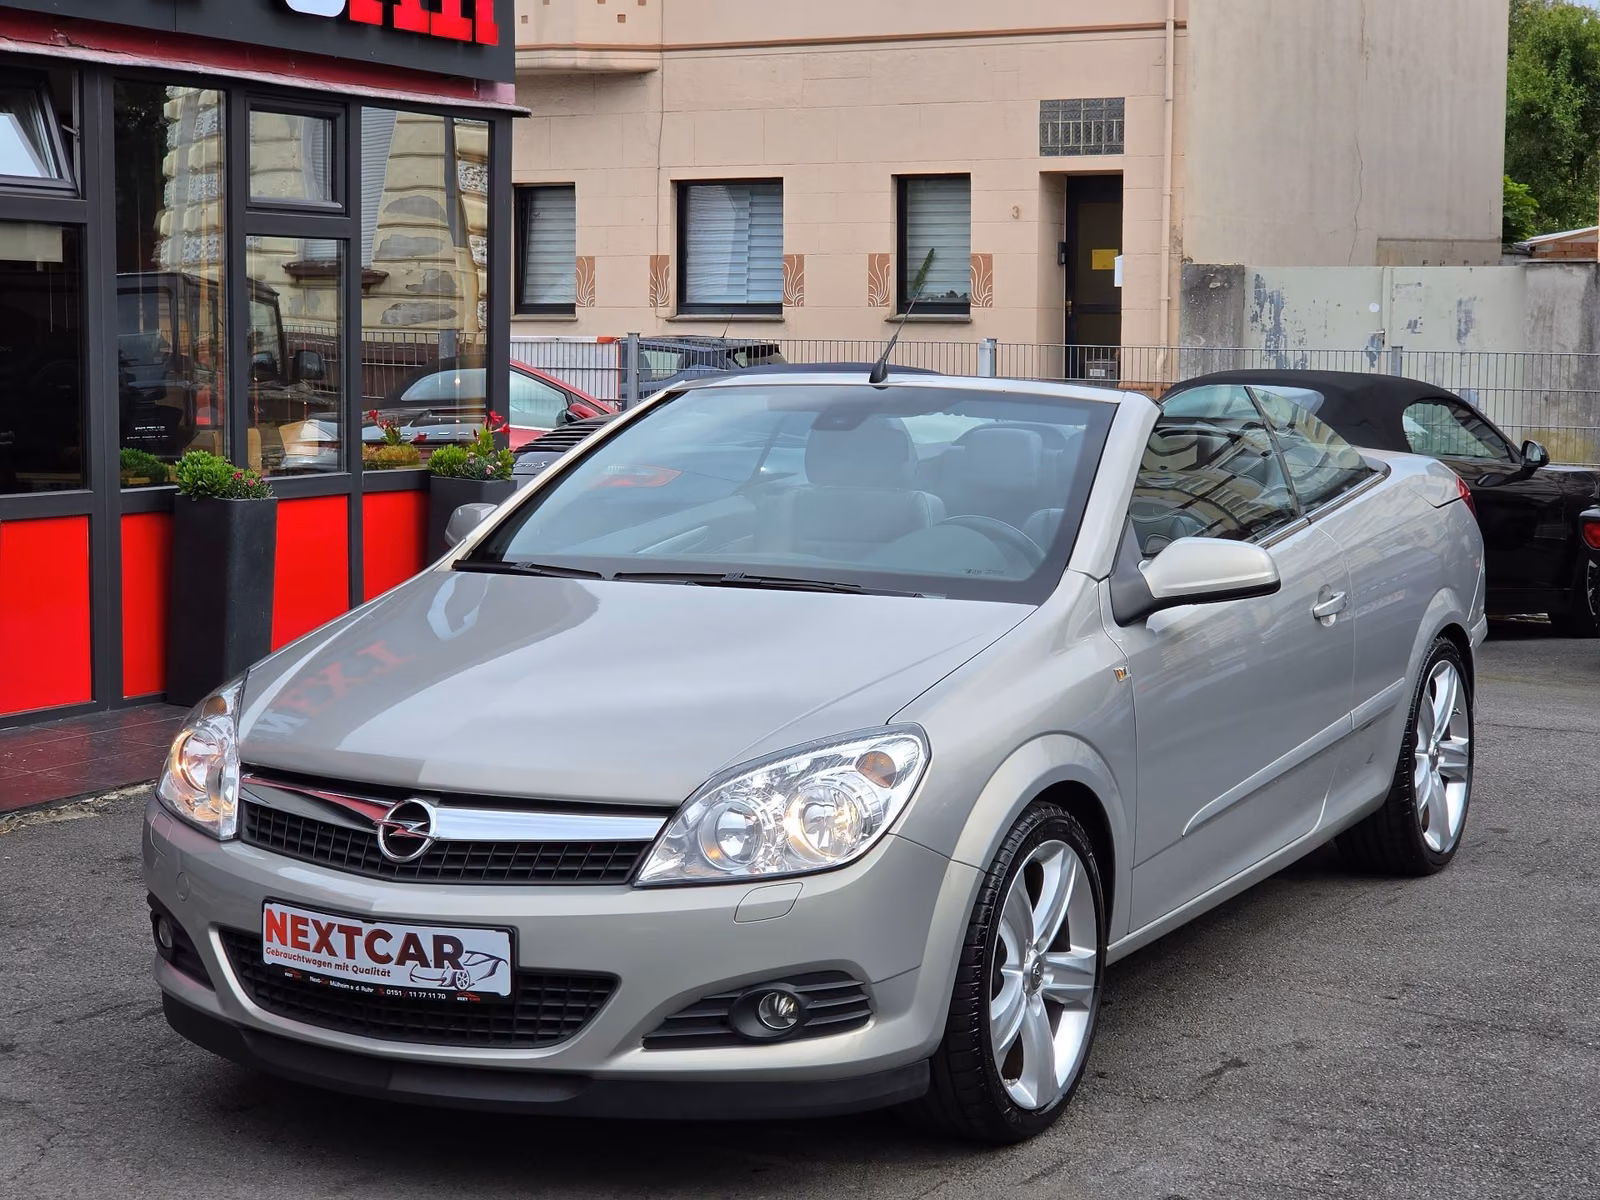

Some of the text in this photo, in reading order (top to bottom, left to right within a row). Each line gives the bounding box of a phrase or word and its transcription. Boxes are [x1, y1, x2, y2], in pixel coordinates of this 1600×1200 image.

[1012, 205, 1020, 220] 3
[264, 908, 465, 971] NEXTCAR
[265, 947, 391, 979] Gebrauchtwagen mit Qualität
